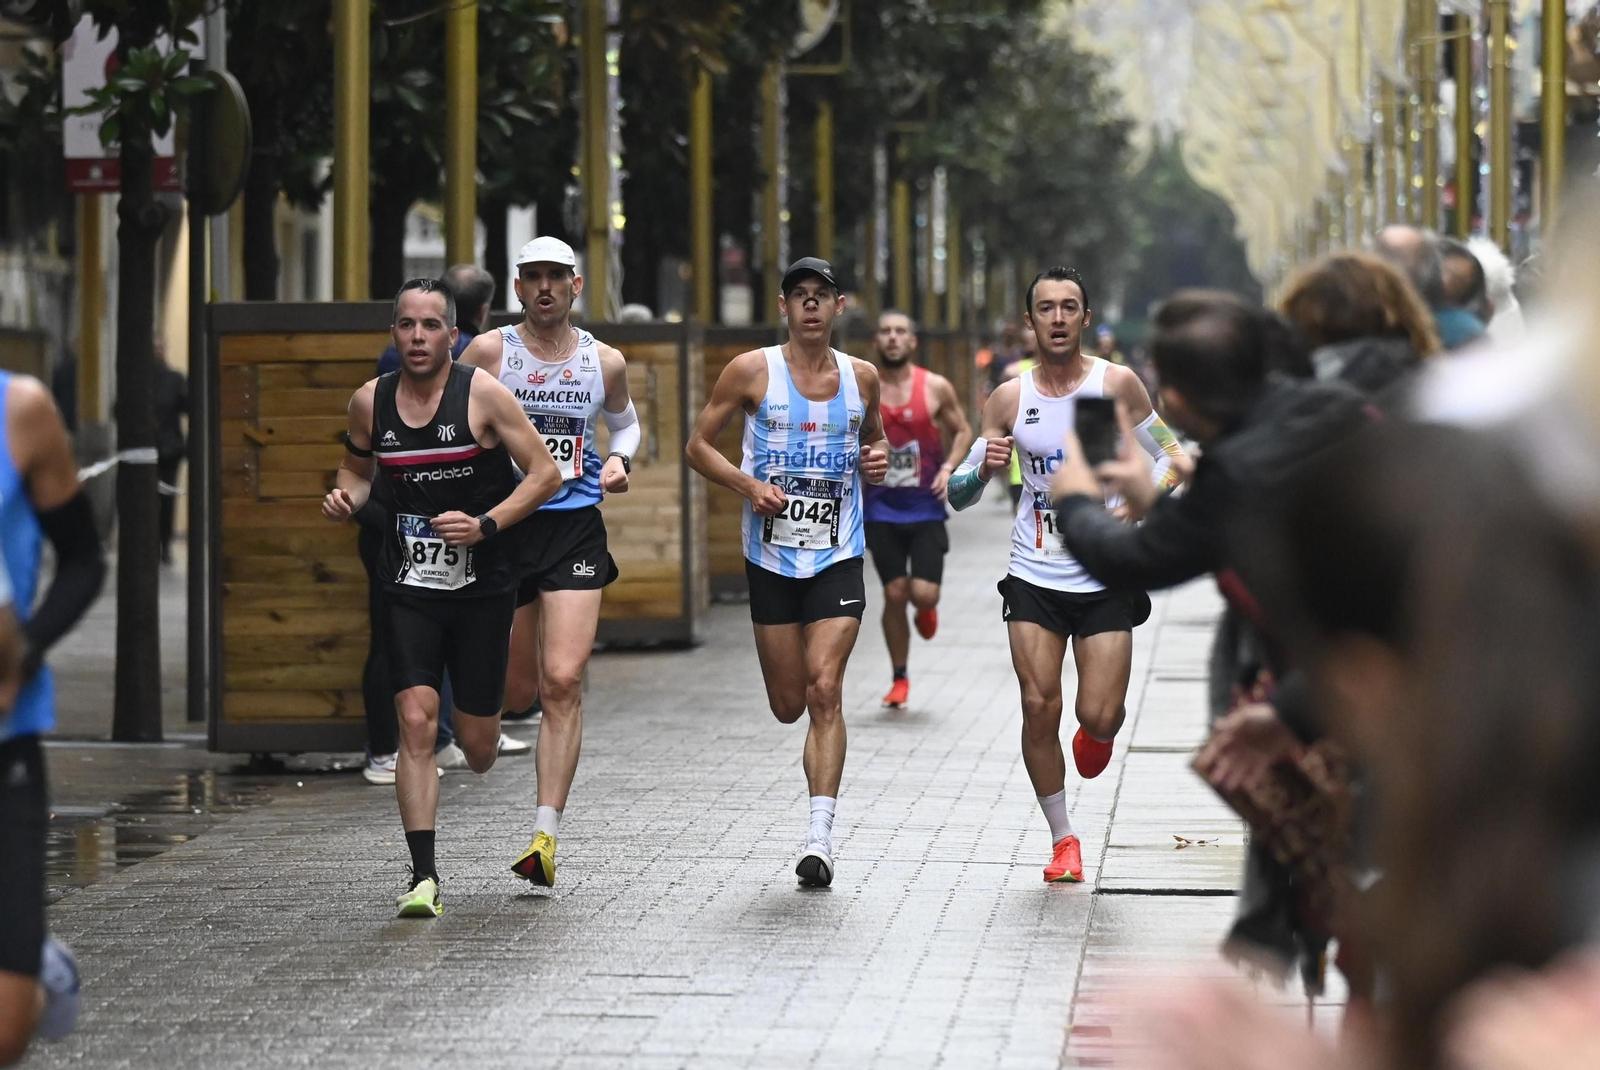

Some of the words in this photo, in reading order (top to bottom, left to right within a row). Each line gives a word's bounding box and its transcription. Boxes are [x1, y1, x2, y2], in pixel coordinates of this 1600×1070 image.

[514, 388, 592, 404] MARACENA
[768, 403, 789, 411] vive
[403, 466, 474, 482] rundata
[774, 500, 833, 524] 2042
[412, 540, 459, 566] 875
[420, 569, 450, 577] FRANCISCO
[572, 559, 596, 576] als
